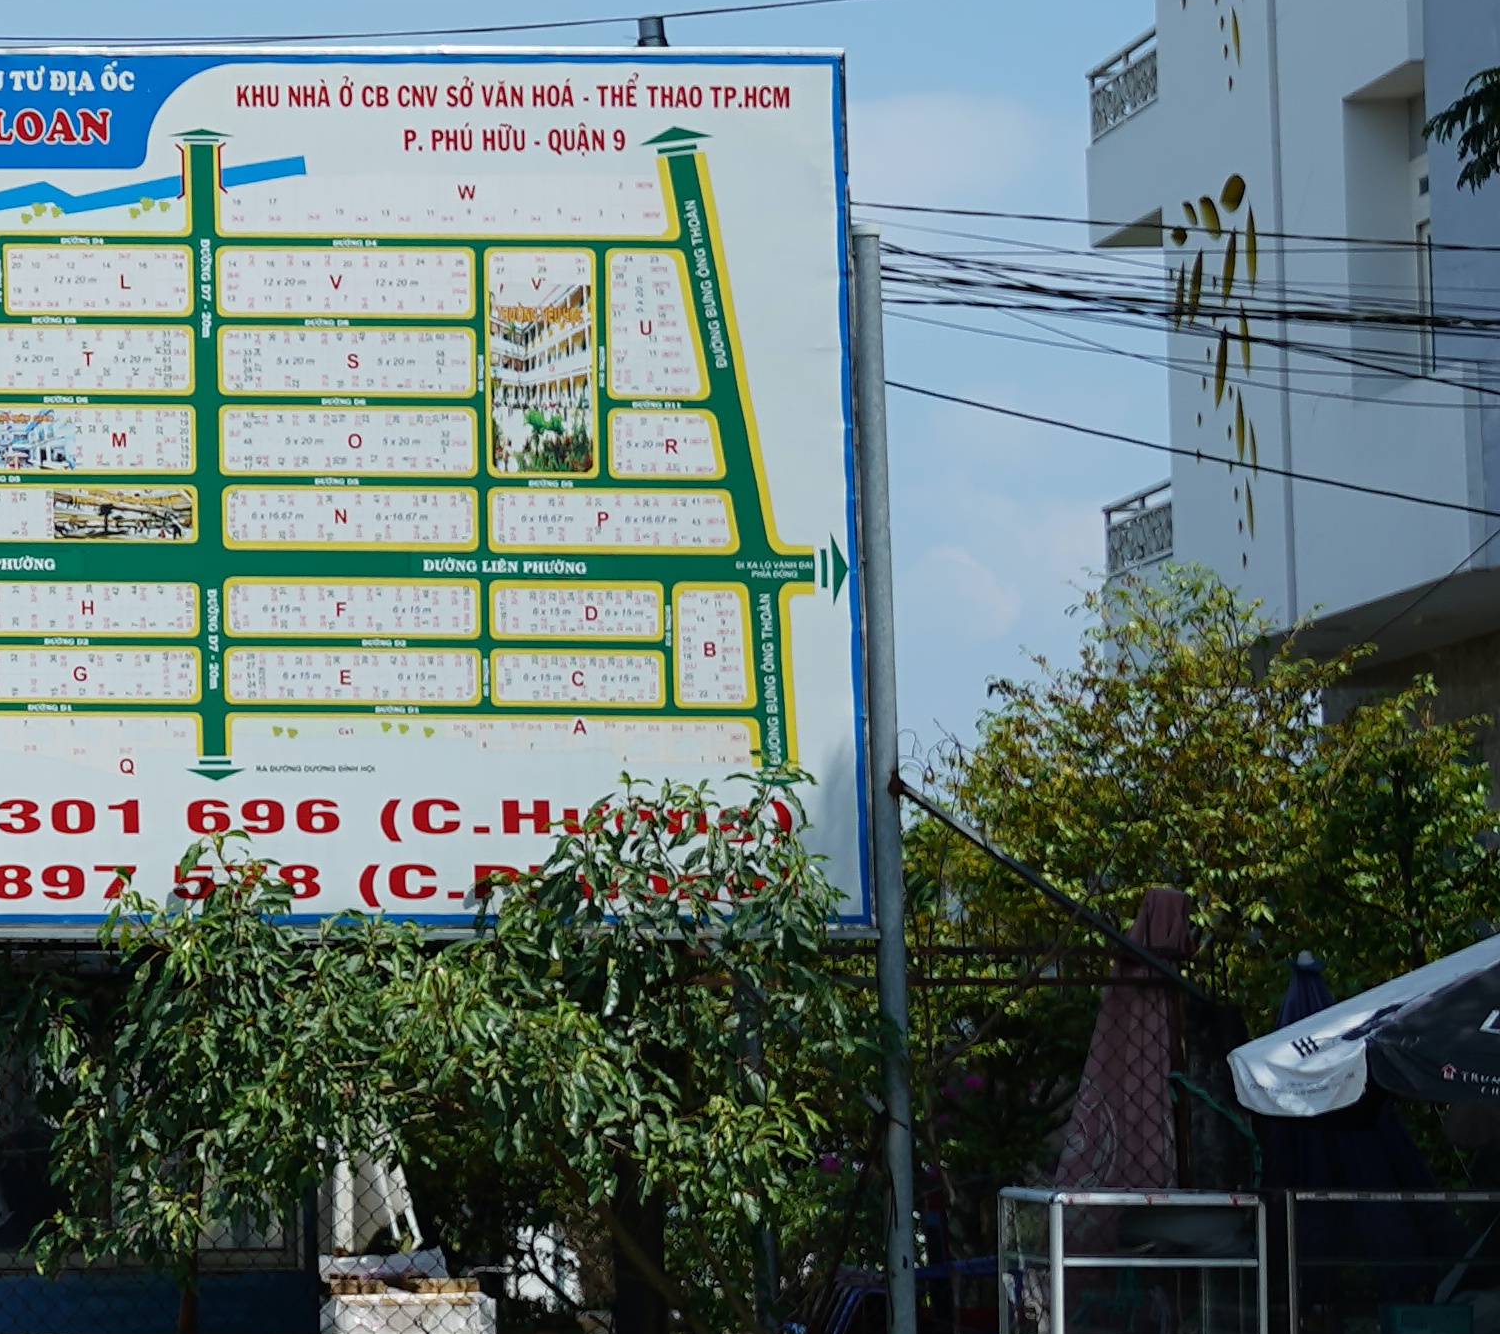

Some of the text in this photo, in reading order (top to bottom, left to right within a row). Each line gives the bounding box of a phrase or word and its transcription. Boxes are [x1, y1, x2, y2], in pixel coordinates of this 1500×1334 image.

[9, 66, 45, 91] TƯ
[49, 70, 95, 96] ĐỊA
[102, 61, 135, 91] ỐC
[236, 72, 791, 109] KHU NHÀ Ở CB CNV SỞ VĂN HOÁ THỂ THAO TP.HCM
[404, 122, 626, 156] P. PHÚ HỮU QUẬN 9
[458, 184, 476, 201] W
[121, 274, 131, 289] L
[329, 275, 342, 289] V
[640, 320, 652, 336] U
[83, 351, 94, 367] T
[347, 353, 359, 369] S
[112, 433, 127, 448] M
[348, 433, 362, 449] O
[664, 438, 678, 454] R
[334, 509, 347, 524] N
[597, 512, 609, 527] P
[423, 557, 587, 575] ĐƯỜNG LIÊN PHƯỜNG
[82, 601, 94, 615] H
[336, 602, 347, 617] F
[585, 606, 598, 621] D
[704, 642, 716, 657] B
[73, 666, 88, 682] G
[339, 669, 352, 685] E
[571, 671, 584, 687] C
[573, 719, 587, 735] A
[119, 758, 135, 775] Q
[186, 799, 341, 834] 696
